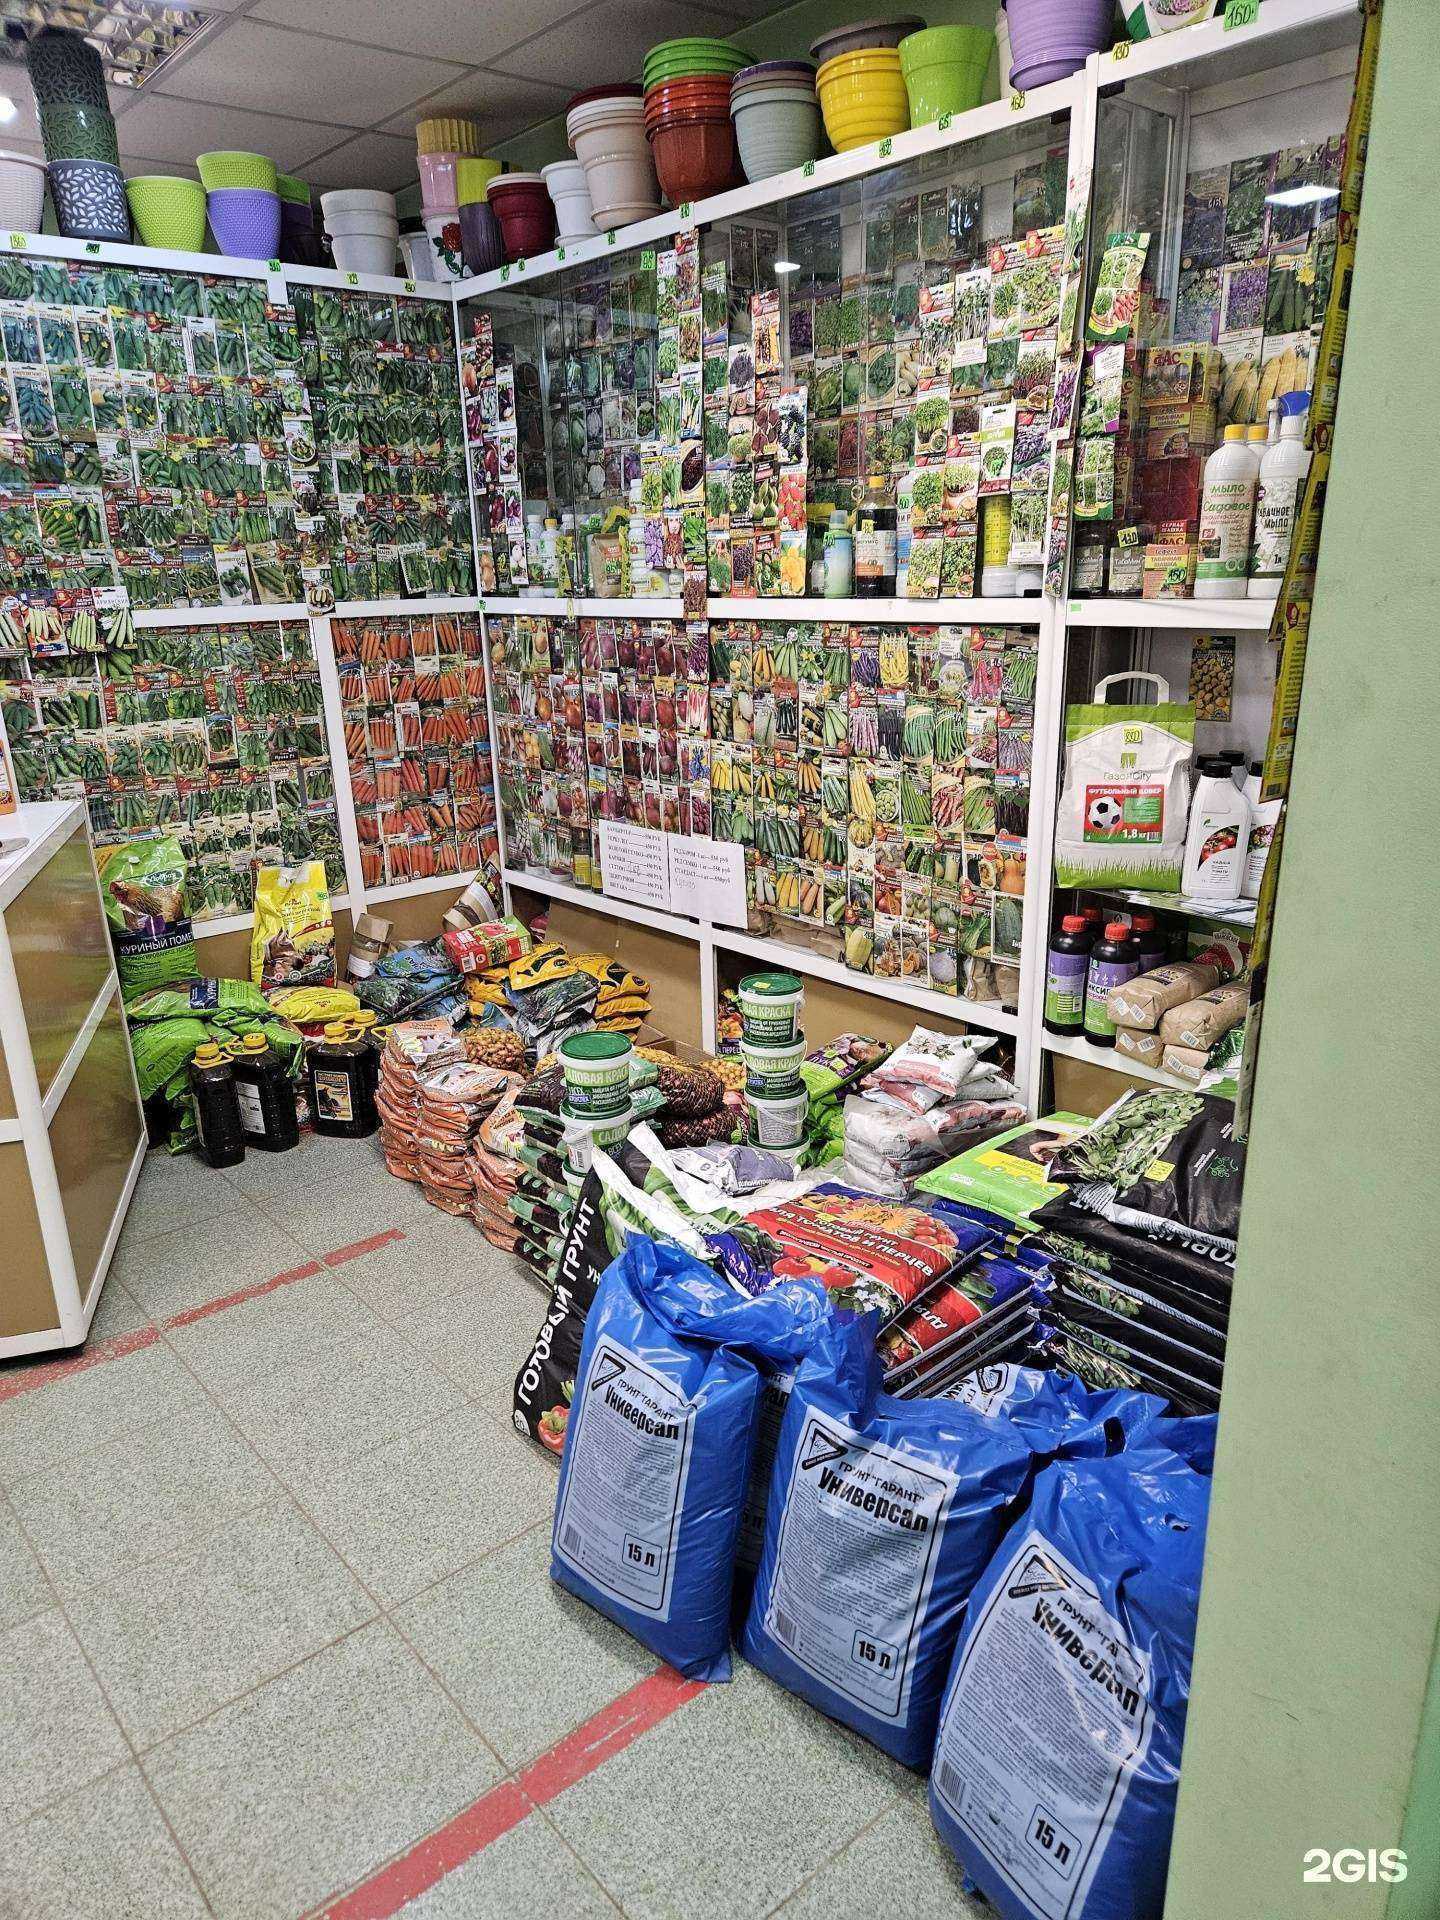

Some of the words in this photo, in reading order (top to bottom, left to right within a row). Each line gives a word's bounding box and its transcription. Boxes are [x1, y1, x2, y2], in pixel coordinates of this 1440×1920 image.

[1211, 484, 1245, 494] МЫЛО
[1203, 501, 1250, 512] Садовое
[1264, 518, 1289, 529] МЫЛО
[1088, 786, 1138, 795] ФУТБОЛЬНЫЙ
[1123, 828, 1138, 839] 1,8
[120, 937, 168, 954] КУРИНЫЙ
[169, 931, 194, 946] ПОМЕ
[759, 1005, 792, 1018] КРАСКА
[874, 1242, 935, 1278] ПЕРЦЕВ
[517, 1283, 573, 1406] ГОТОВЫЙ
[562, 1195, 596, 1283] ГРУНТ
[616, 1378, 642, 1401] ГРУНТ
[605, 1384, 680, 1441] Универсал
[838, 1460, 871, 1484] ГРУНТ
[871, 1473, 926, 1505] "ГАРАНТ"
[817, 1466, 928, 1533] Универсал
[627, 1542, 642, 1562] 15
[643, 1550, 656, 1568] л
[1057, 1596, 1097, 1633] ГРУНТ
[857, 1639, 876, 1663] 15
[878, 1650, 892, 1671] л
[1035, 1817, 1056, 1850] 15
[1055, 1843, 1073, 1867] л
